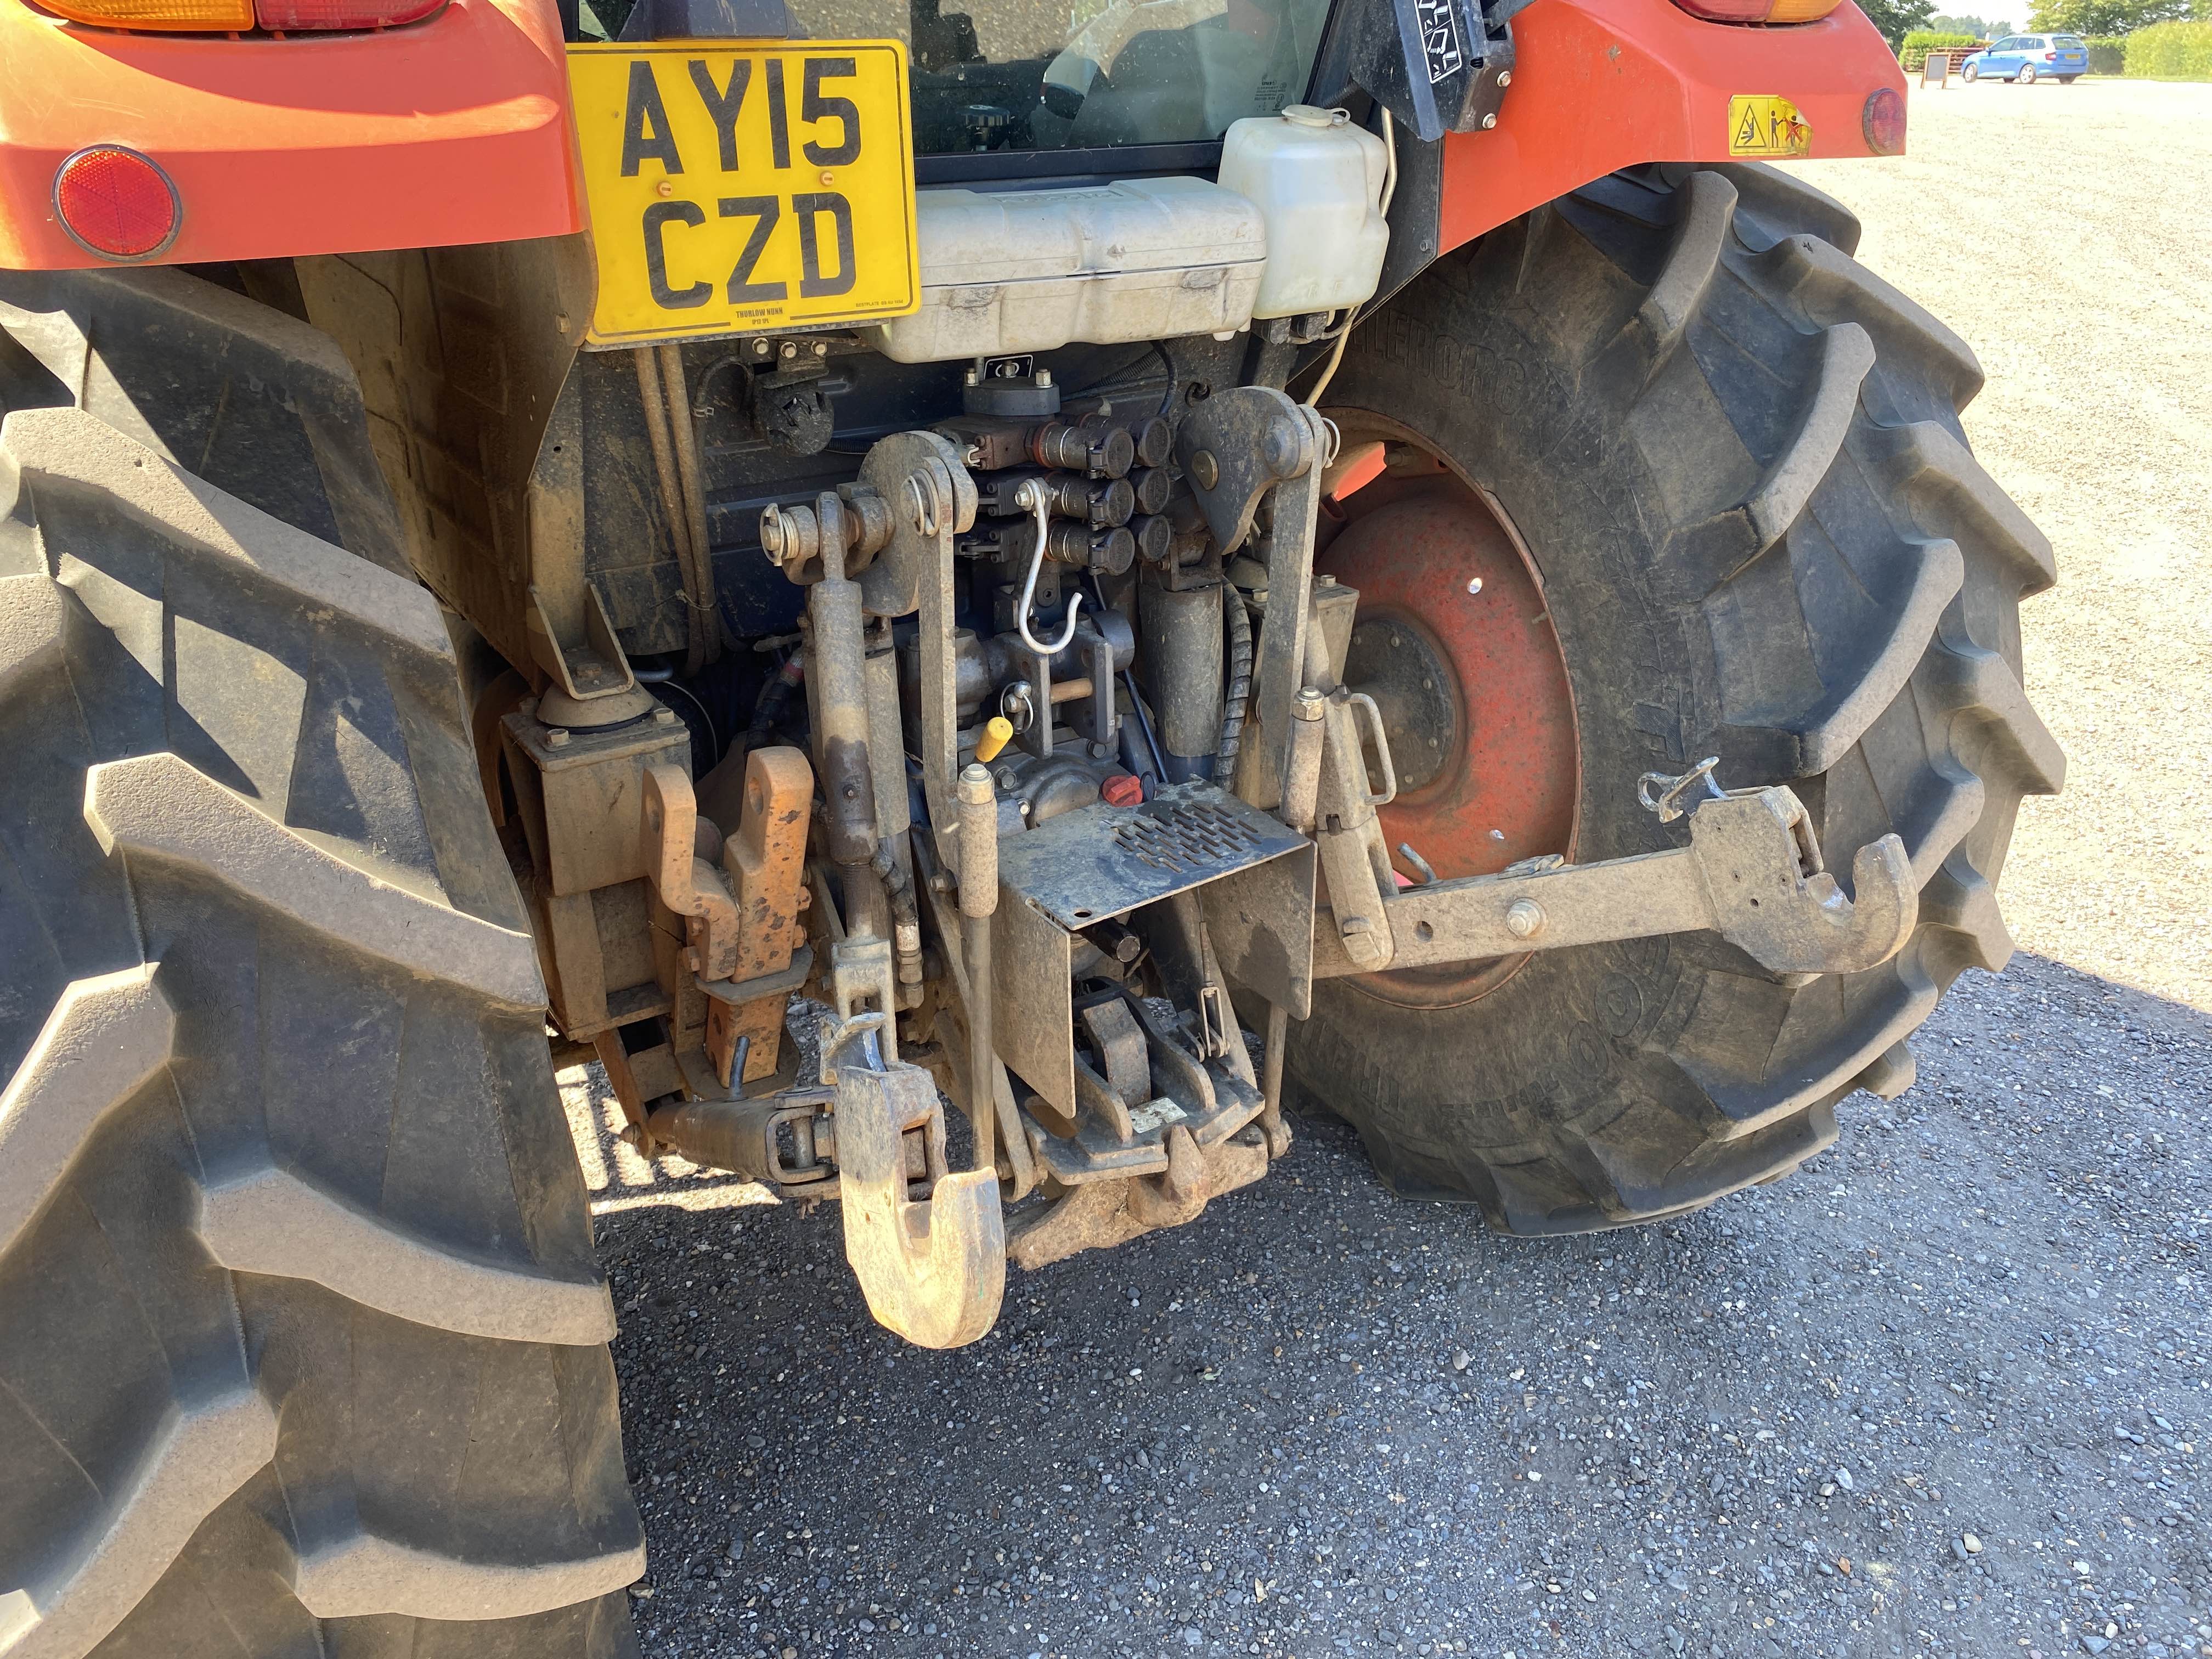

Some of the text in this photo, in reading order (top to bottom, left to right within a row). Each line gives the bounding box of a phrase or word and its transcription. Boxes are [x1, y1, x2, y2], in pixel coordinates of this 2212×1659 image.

[620, 57, 861, 177] AY15
[641, 191, 857, 310] CZD
[736, 307, 783, 318] THURLOW NUNN
